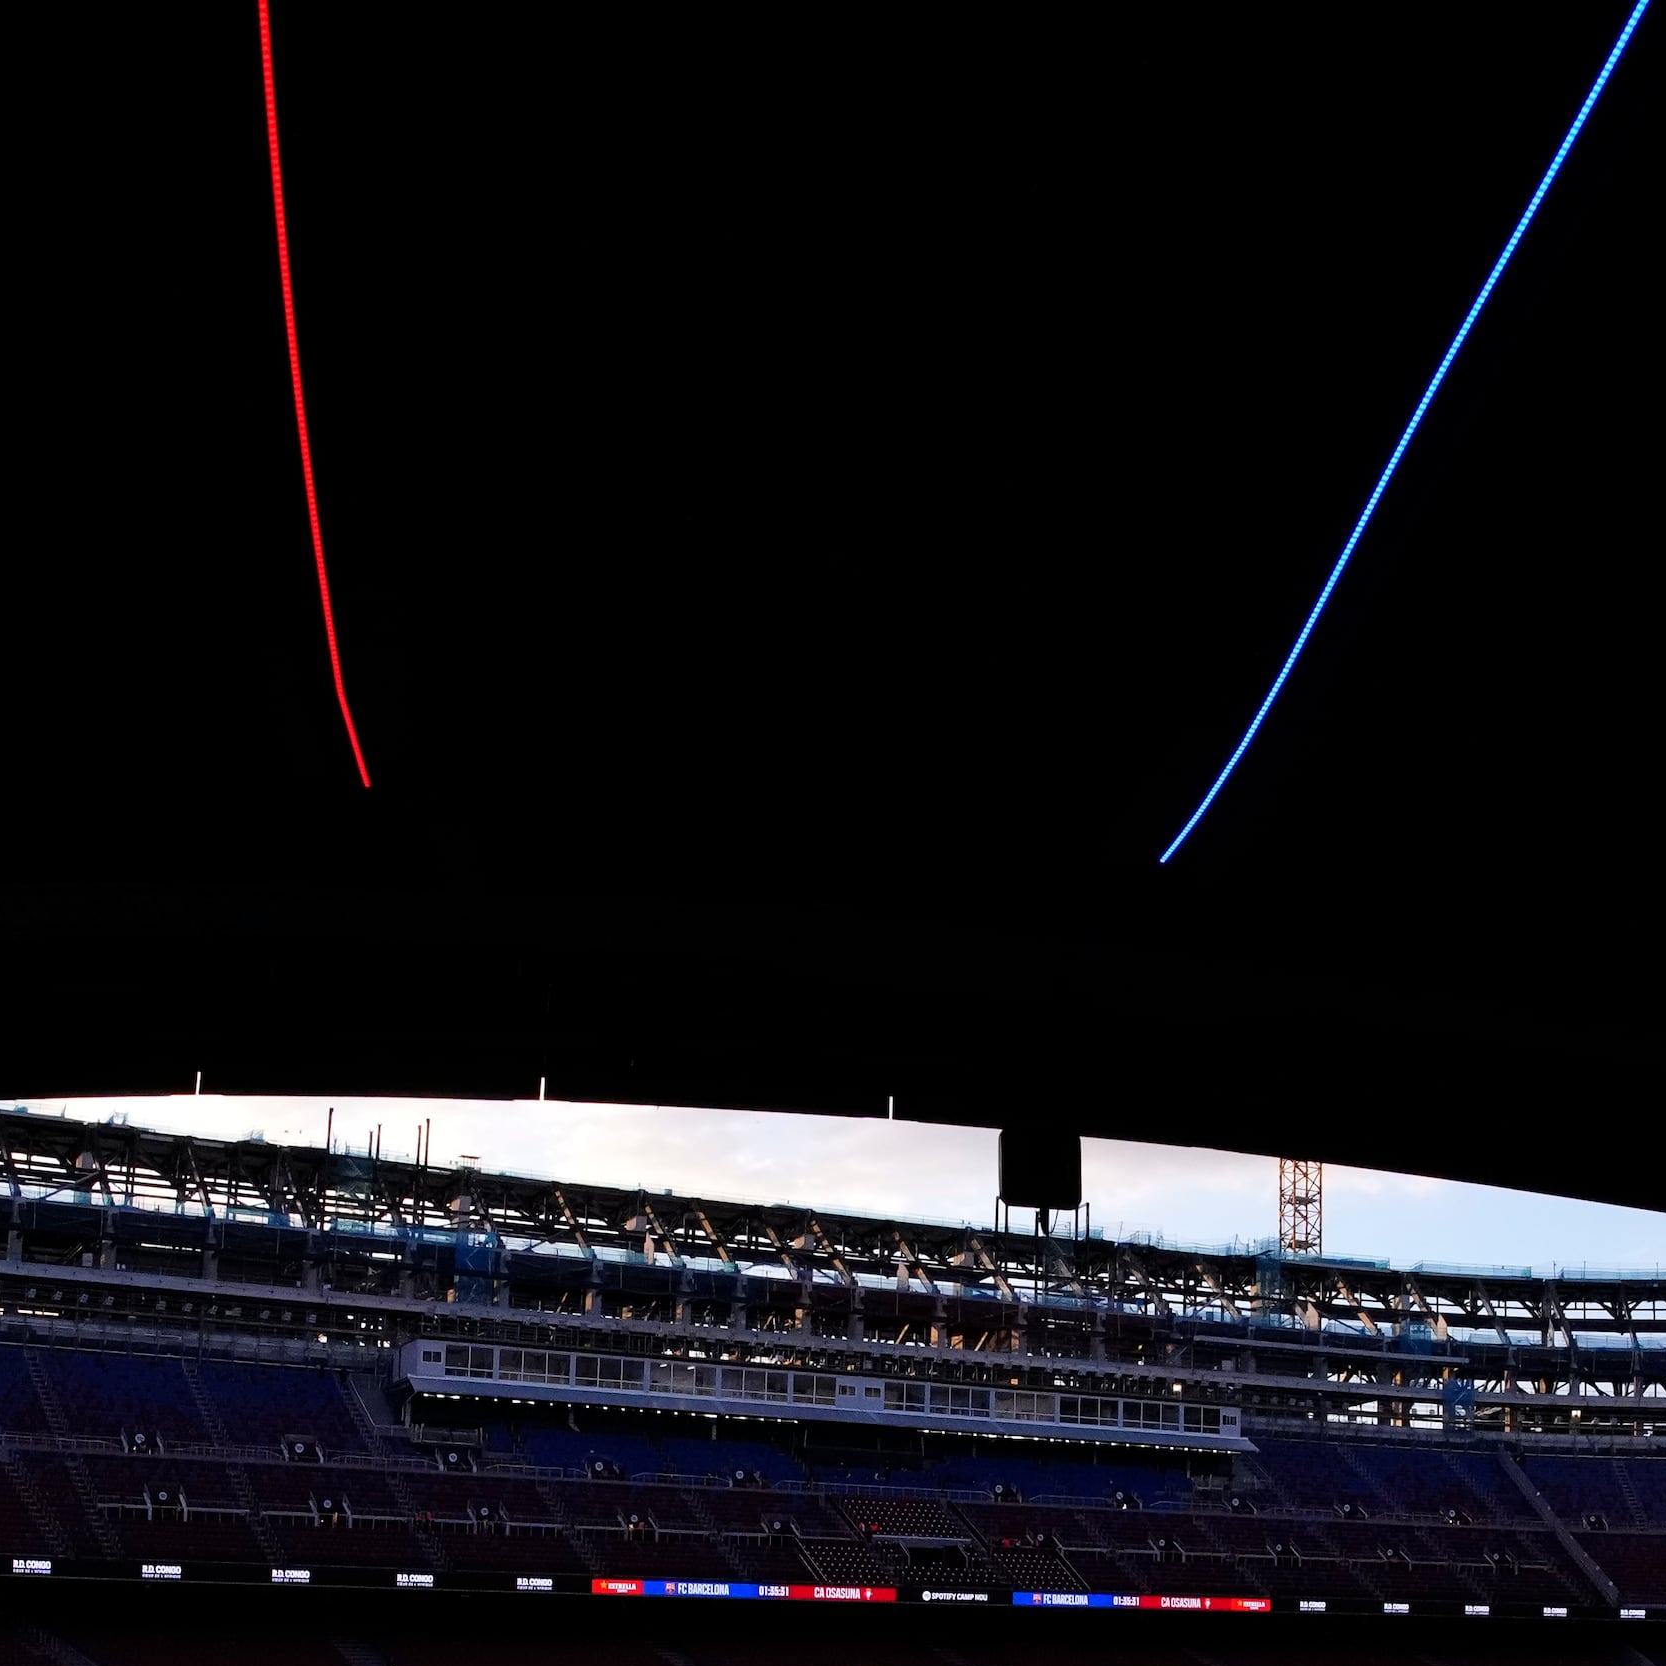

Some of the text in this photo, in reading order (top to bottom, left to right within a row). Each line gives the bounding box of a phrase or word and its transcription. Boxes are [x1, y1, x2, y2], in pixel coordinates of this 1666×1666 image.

[26, 1560, 51, 1569] CONGO
[155, 1565, 181, 1574] CONGO
[285, 1569, 310, 1578] CONGO
[409, 1574, 434, 1583] CONGO
[529, 1578, 552, 1586] CONGO
[678, 1583, 730, 1596] FC BARCELONA
[759, 1586, 789, 1596] 01:35:31
[814, 1587, 861, 1599] CA OSASUNA
[931, 1593, 956, 1601] SPOTIFY
[956, 1593, 974, 1601] CAMP
[1043, 1595, 1089, 1605] FC BARCELONA
[1161, 1597, 1202, 1608] CA OSASUNA
